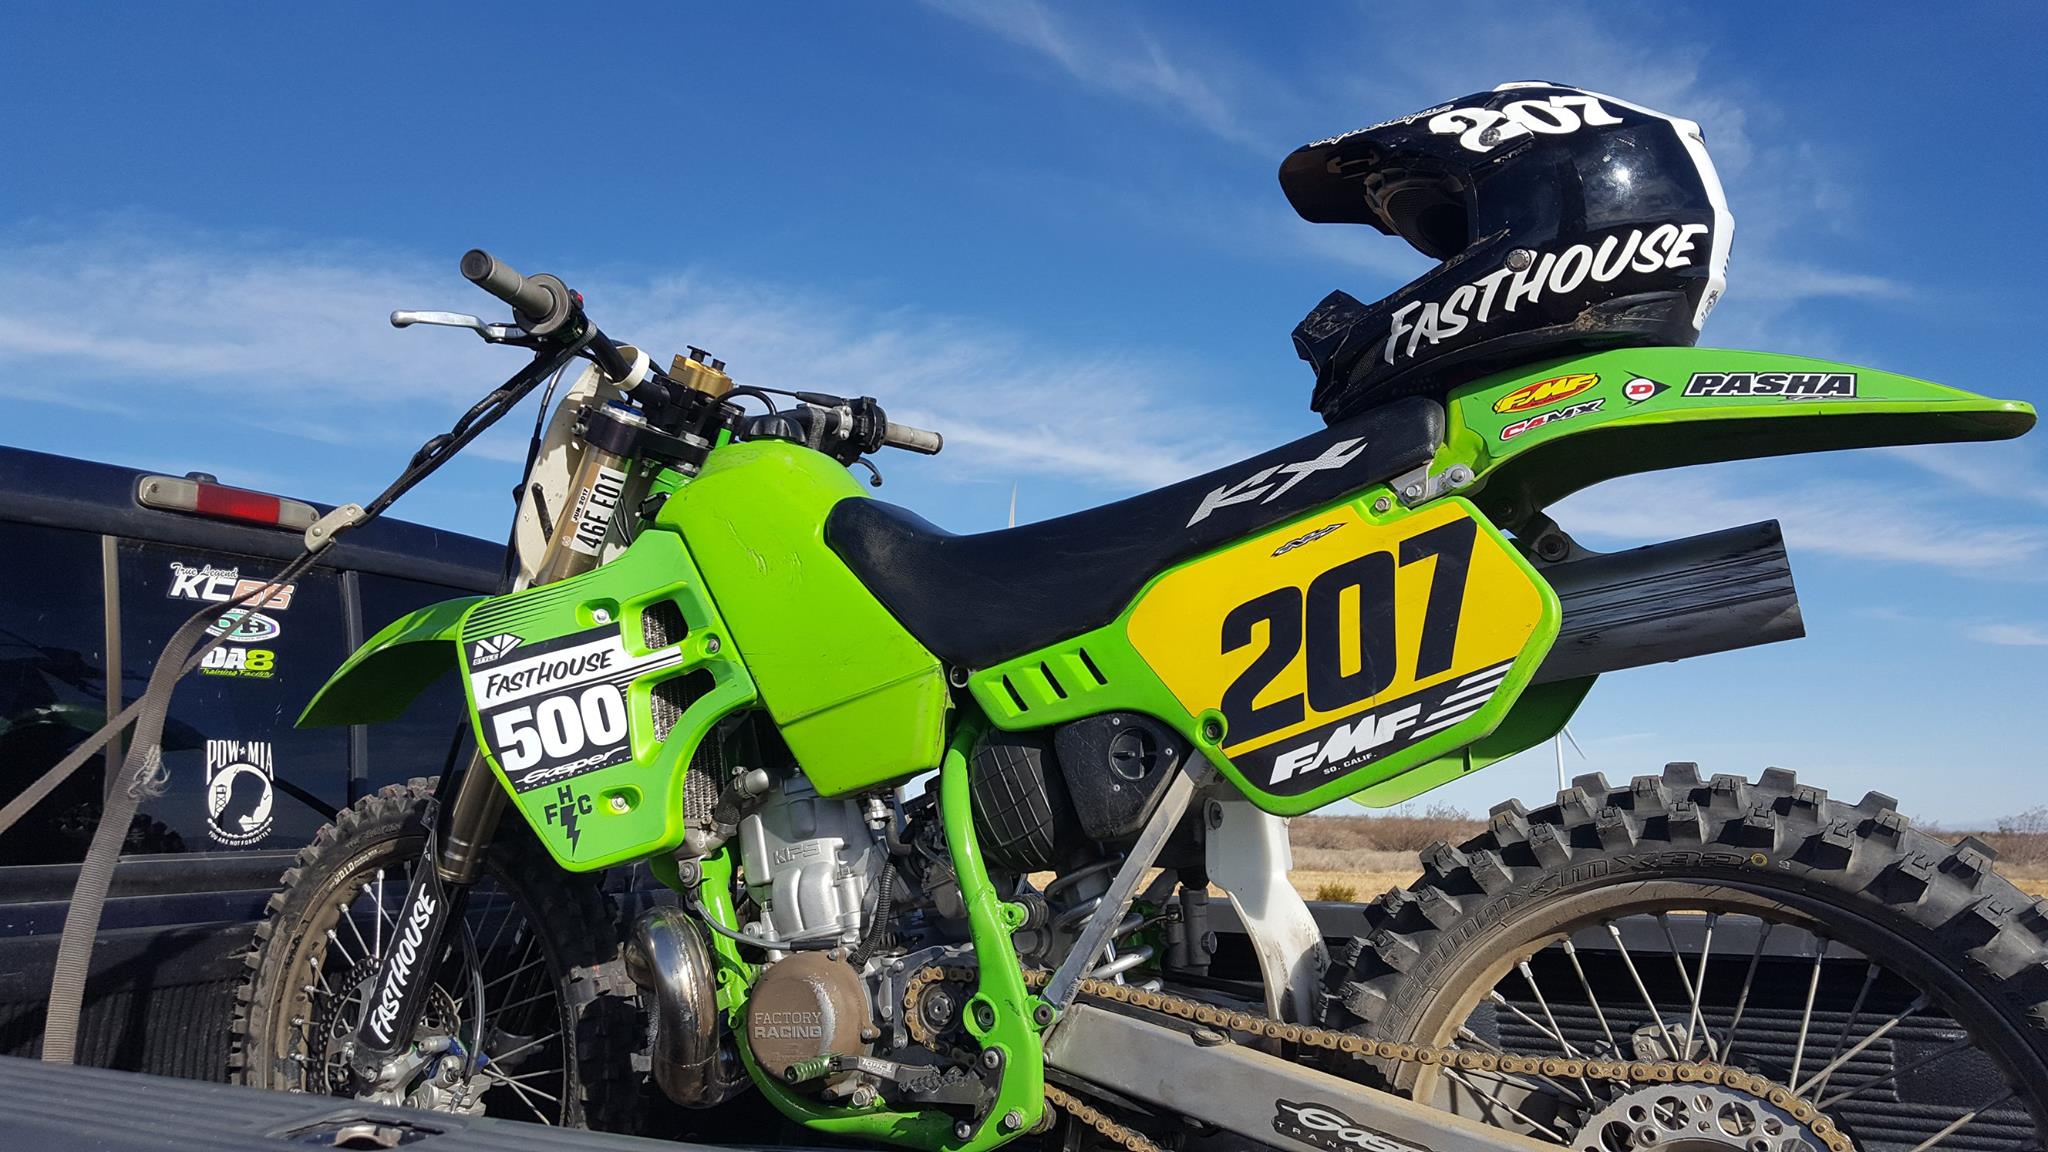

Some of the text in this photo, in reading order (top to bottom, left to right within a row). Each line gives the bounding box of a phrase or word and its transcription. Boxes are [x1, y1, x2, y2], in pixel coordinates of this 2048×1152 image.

[1429, 96, 1623, 153] 207
[1384, 224, 1709, 366] FASTHOUSE
[1494, 373, 1599, 413] FMF
[1688, 374, 1851, 396] PASHA
[1501, 399, 1605, 440] C4MX
[573, 488, 589, 520] JUN 2017
[1186, 436, 1368, 528] KX
[170, 562, 239, 580] True Legend
[1220, 516, 1478, 750] 207
[486, 648, 615, 699] FASTHOUSE
[493, 684, 628, 772] 500
[1269, 703, 1422, 786] FMF
[206, 739, 274, 786] POW MIA
[1323, 752, 1377, 775] SO. CALIF.
[208, 830, 218, 840] YOU
[217, 837, 229, 846] ARE
[241, 828, 272, 846] FORGOTTEN
[370, 883, 436, 1044] FASTHOUSE
[754, 1011, 822, 1024] FACTORY
[754, 1026, 822, 1039] RACING
